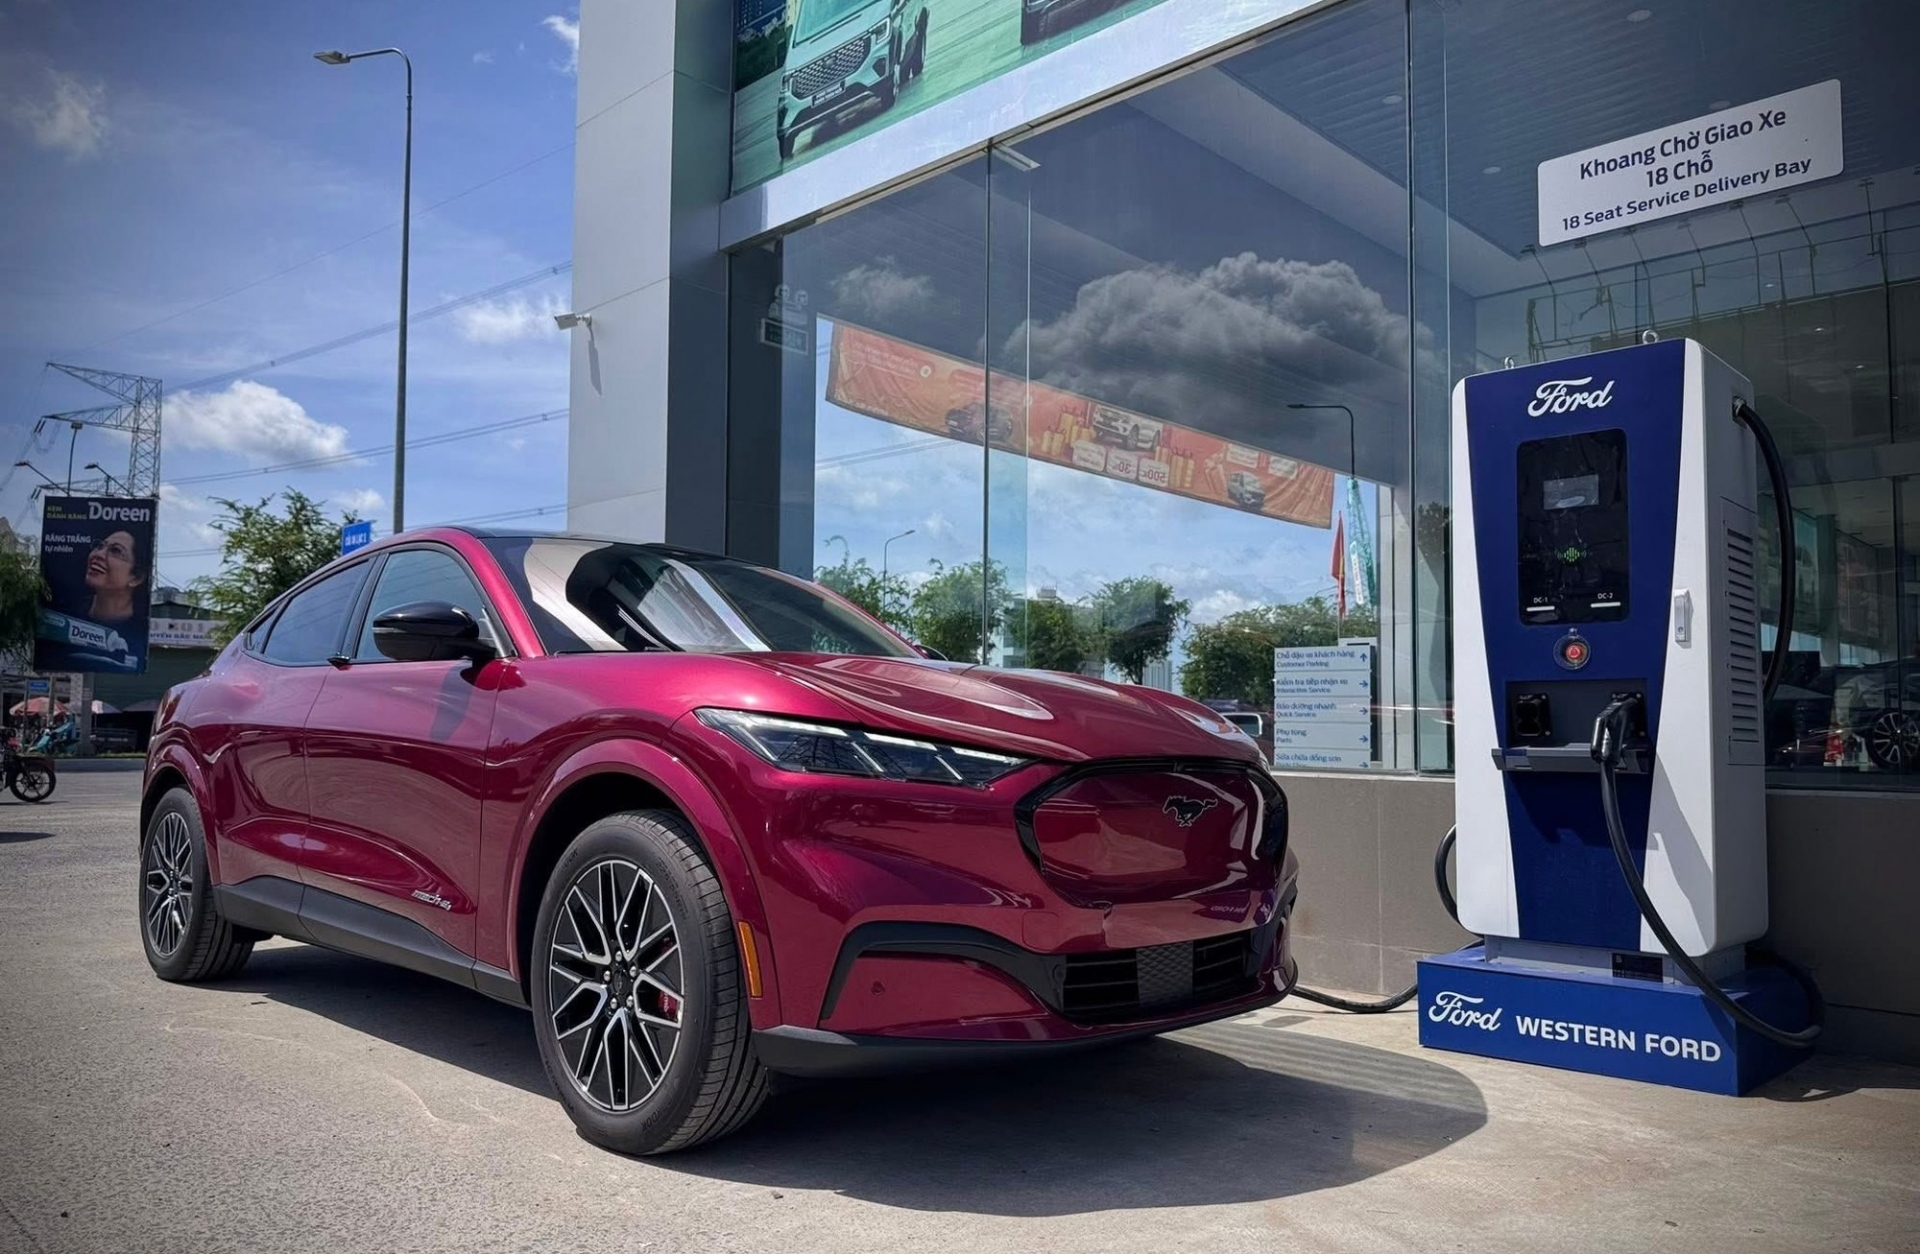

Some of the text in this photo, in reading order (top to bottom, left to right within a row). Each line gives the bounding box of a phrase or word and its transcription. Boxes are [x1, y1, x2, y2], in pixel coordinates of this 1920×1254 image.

[1579, 109, 1787, 180] Khoang Chờ Giao Xe
[1646, 149, 1714, 188] 18 Chỗ
[1562, 158, 1812, 231] 18 Seat Service Delivery Bay
[1527, 376, 1615, 417] Ford
[88, 501, 150, 522] Doreen
[71, 625, 104, 643] Doreen
[1427, 990, 1721, 1062] Ford WESTERN FORD
